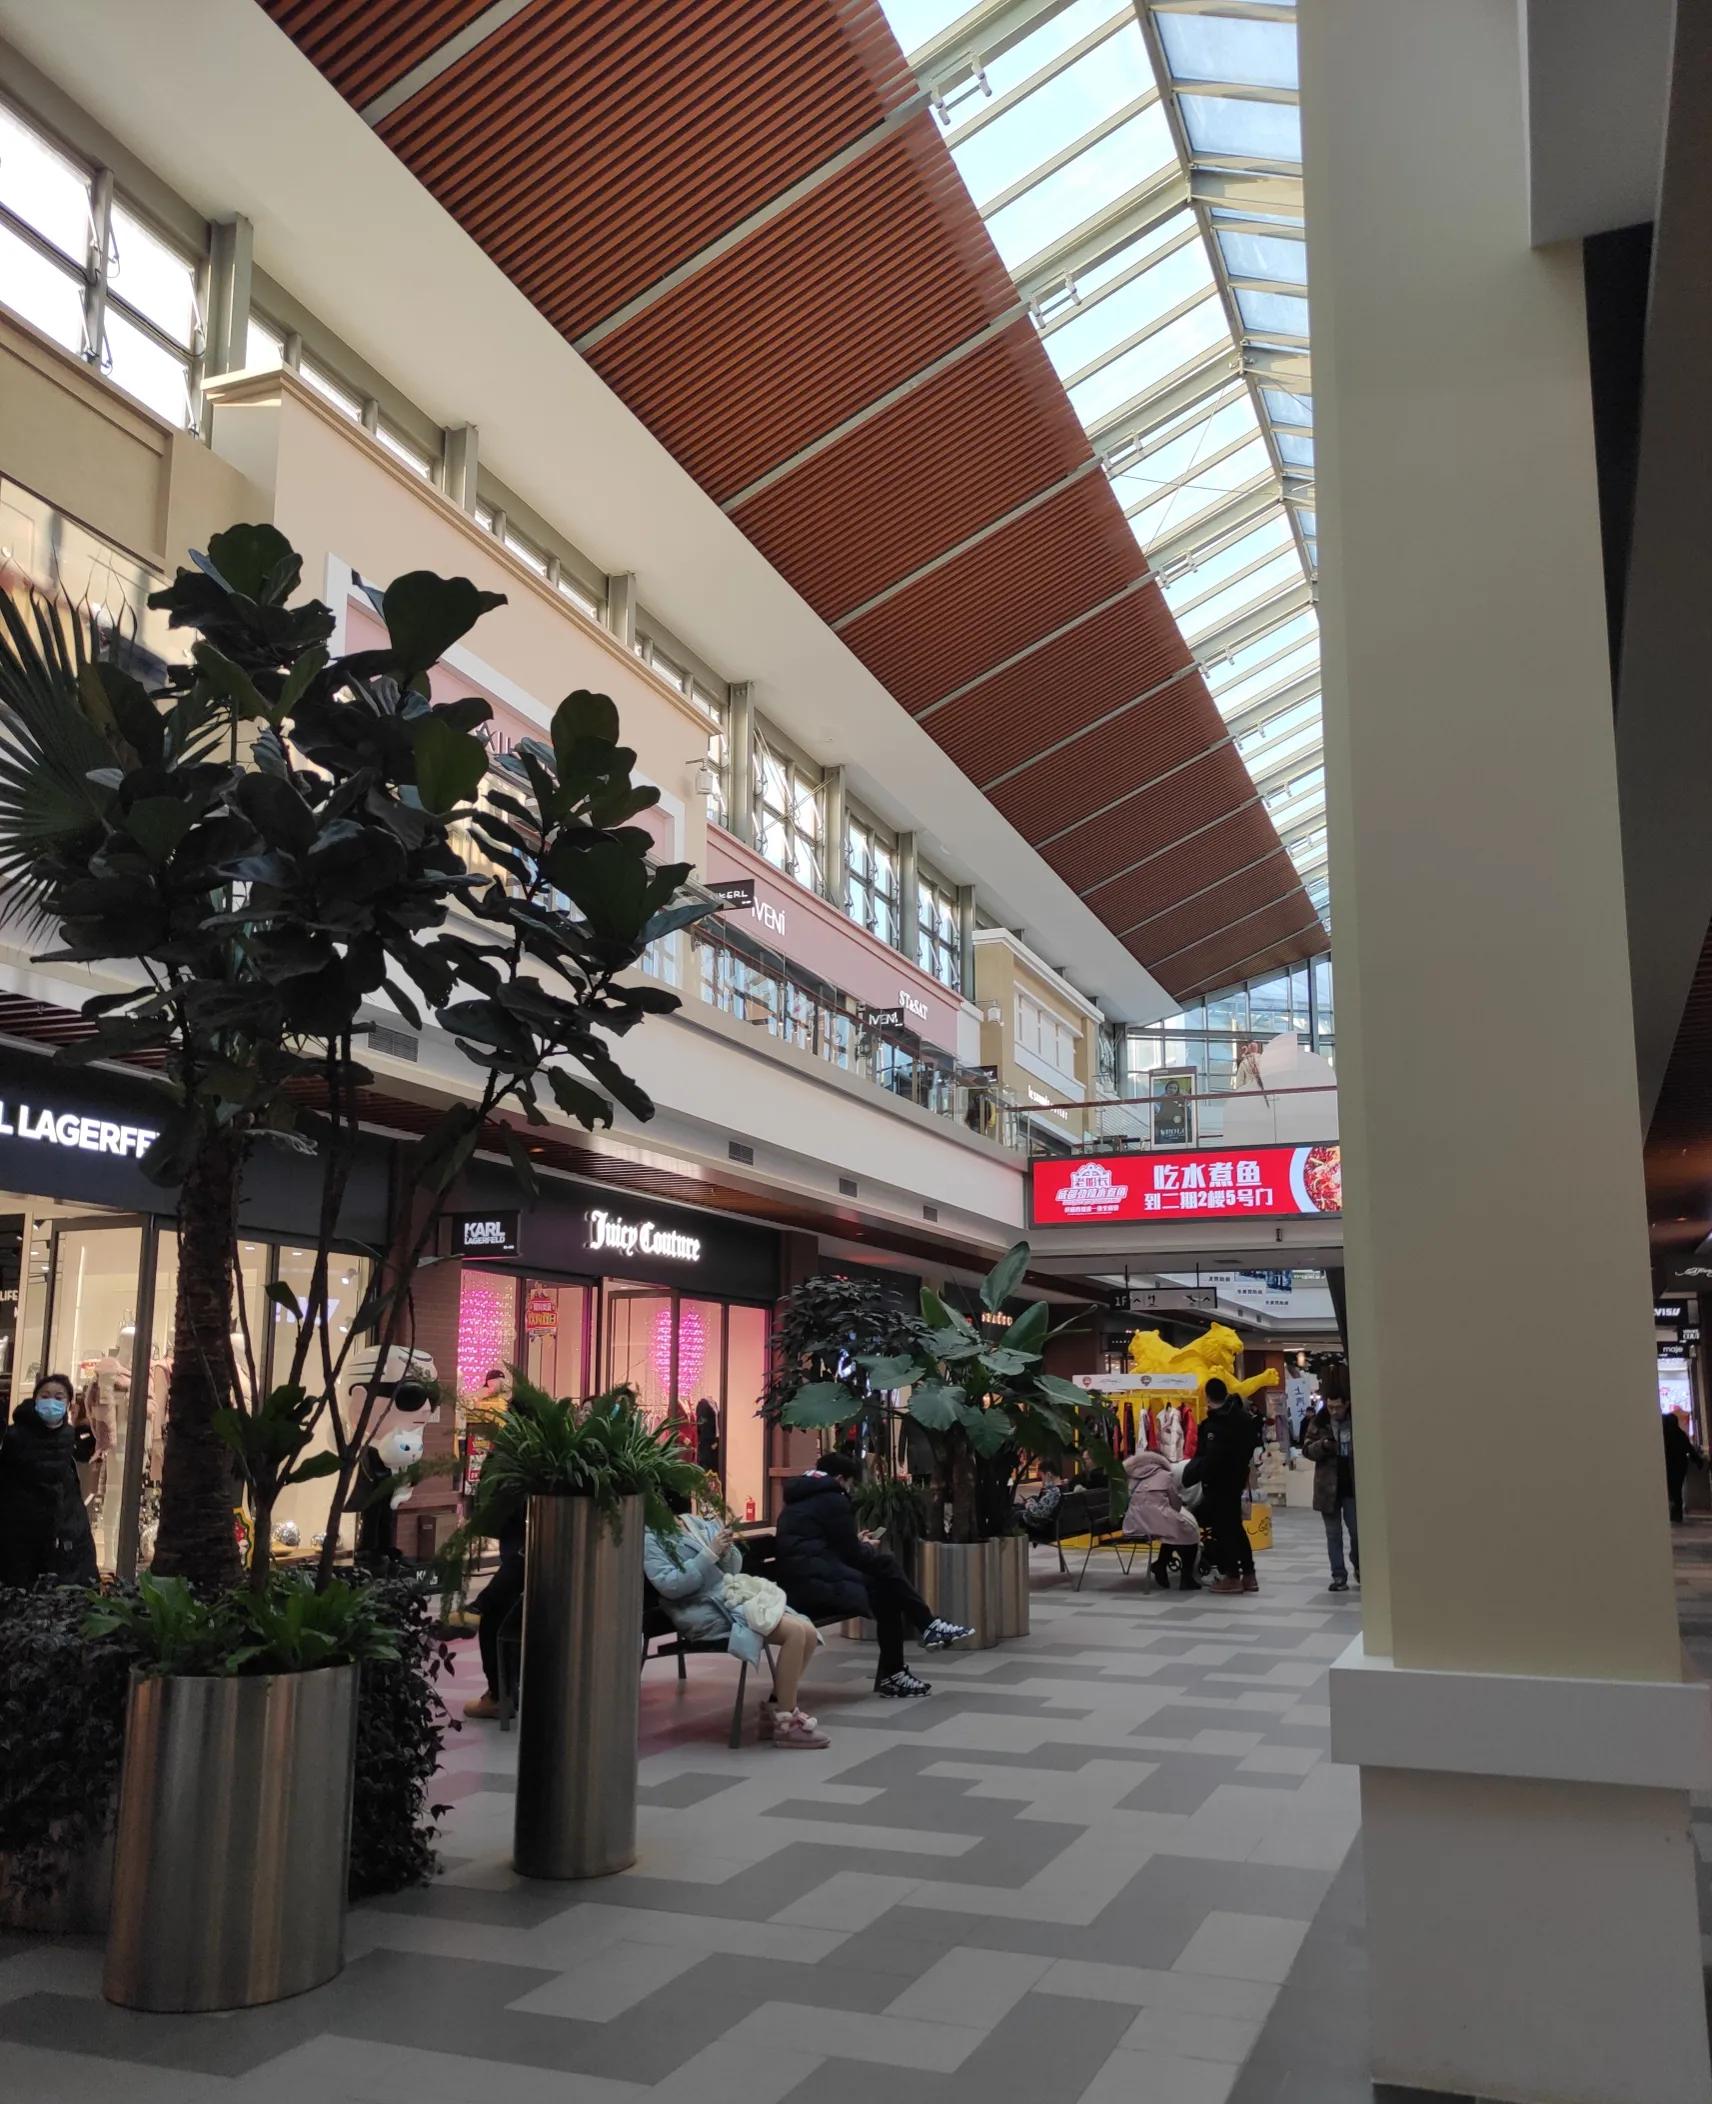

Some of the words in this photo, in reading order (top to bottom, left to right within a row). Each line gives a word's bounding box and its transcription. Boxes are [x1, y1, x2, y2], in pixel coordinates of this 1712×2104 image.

[18, 1104, 160, 1159] LAGERFE
[1153, 1160, 1262, 1190] 吃水煮鱼
[1144, 1188, 1273, 1210] 到二期2楼5号门
[464, 1222, 506, 1237] KARL
[590, 1210, 638, 1256] Juicy
[640, 1221, 700, 1261] Couture
[464, 1236, 506, 1245] LAGERFELD
[1115, 1296, 1127, 1307] 1F
[1662, 1345, 1684, 1354] maje
